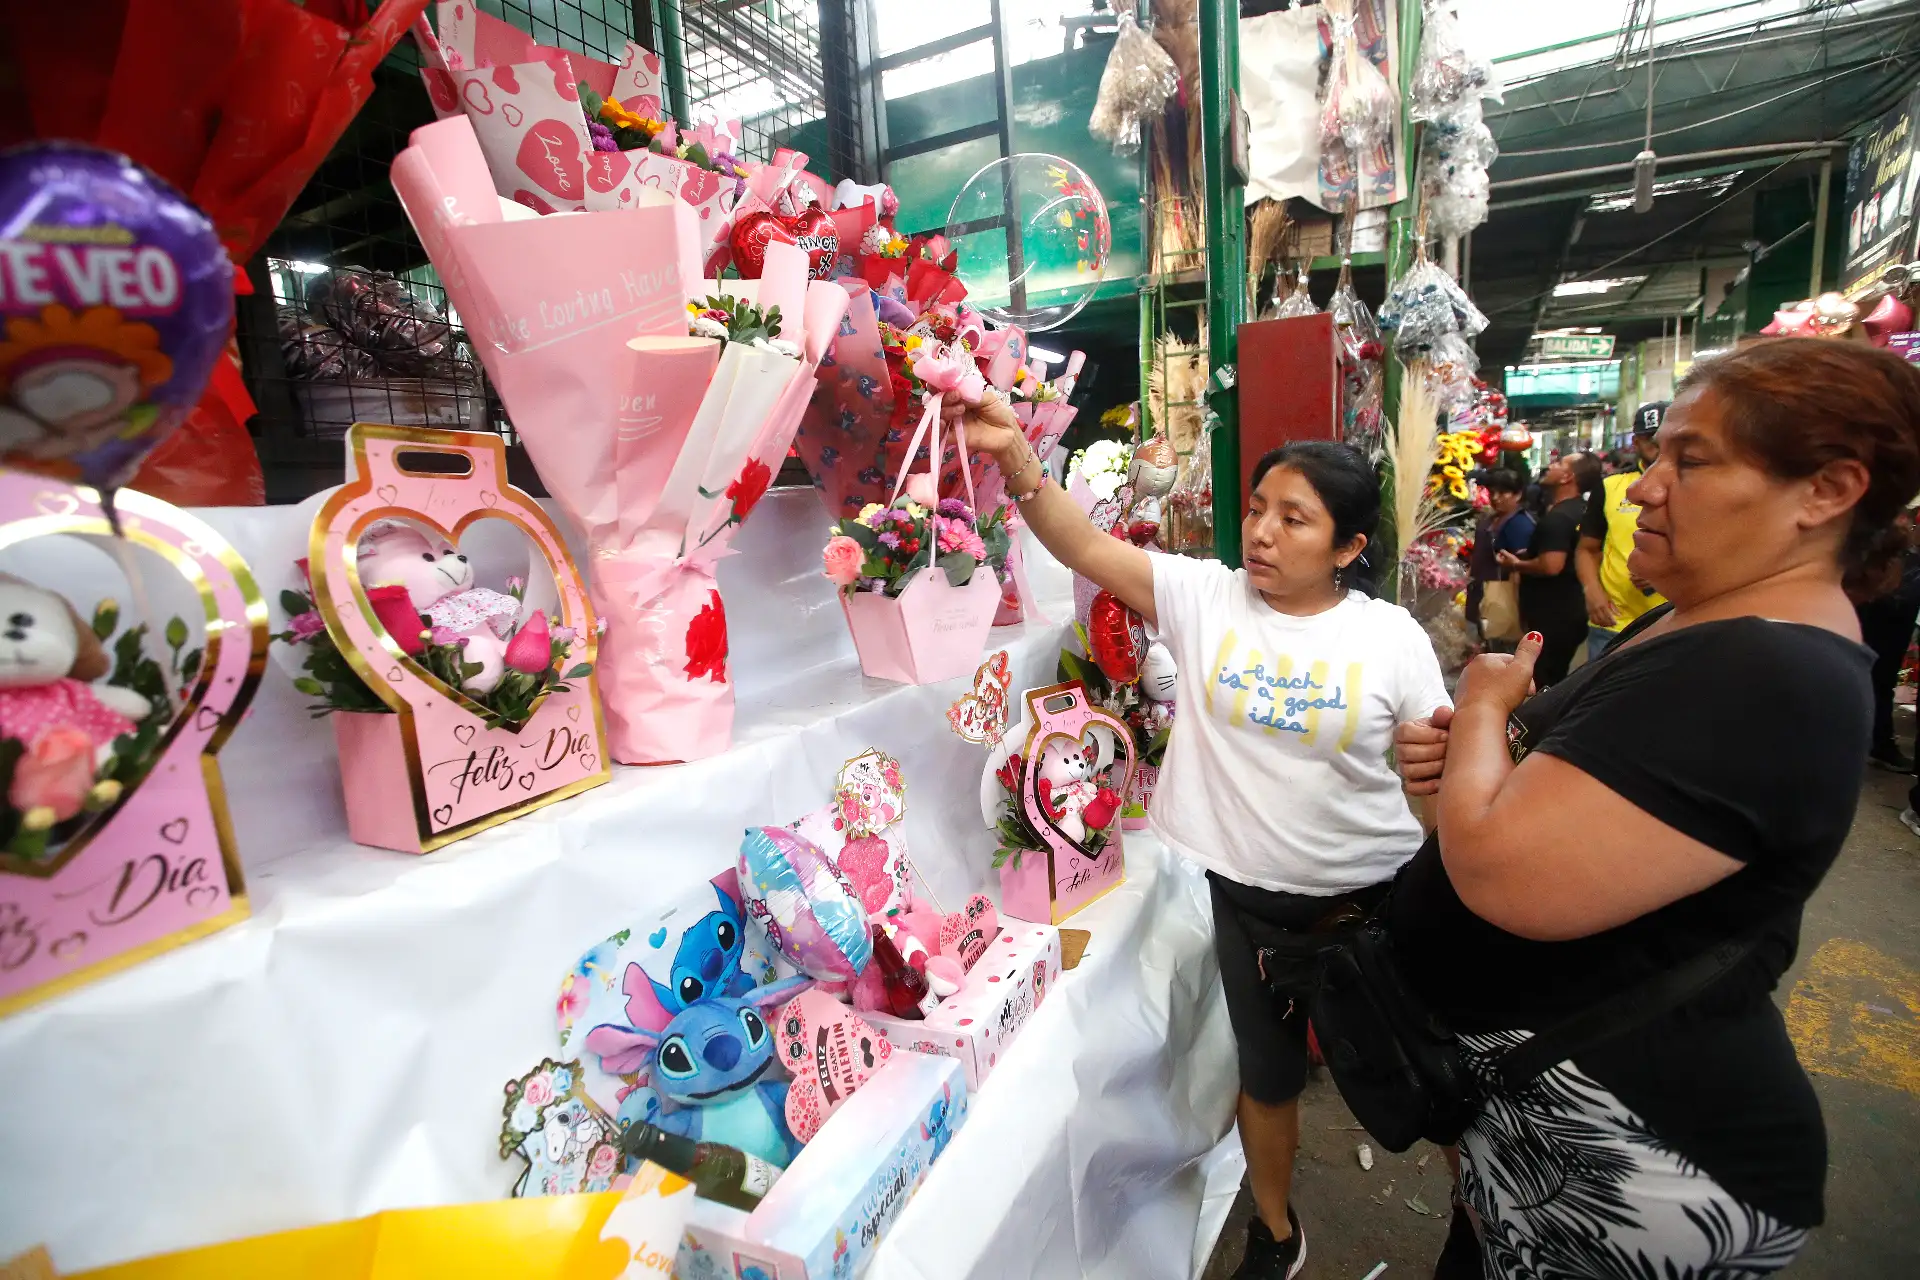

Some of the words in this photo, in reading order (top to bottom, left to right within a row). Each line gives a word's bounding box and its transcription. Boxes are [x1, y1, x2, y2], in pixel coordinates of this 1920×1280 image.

[534, 131, 571, 192] Love
[54, 244, 178, 308] VEO
[538, 288, 615, 330] Loving
[1545, 338, 1589, 355] SALIDA
[1218, 666, 1249, 690] is
[1248, 706, 1309, 734] idea
[1257, 686, 1275, 701] a
[1284, 686, 1348, 717] good
[428, 745, 519, 804] Feliz
[818, 1045, 831, 1088] FELIZ
